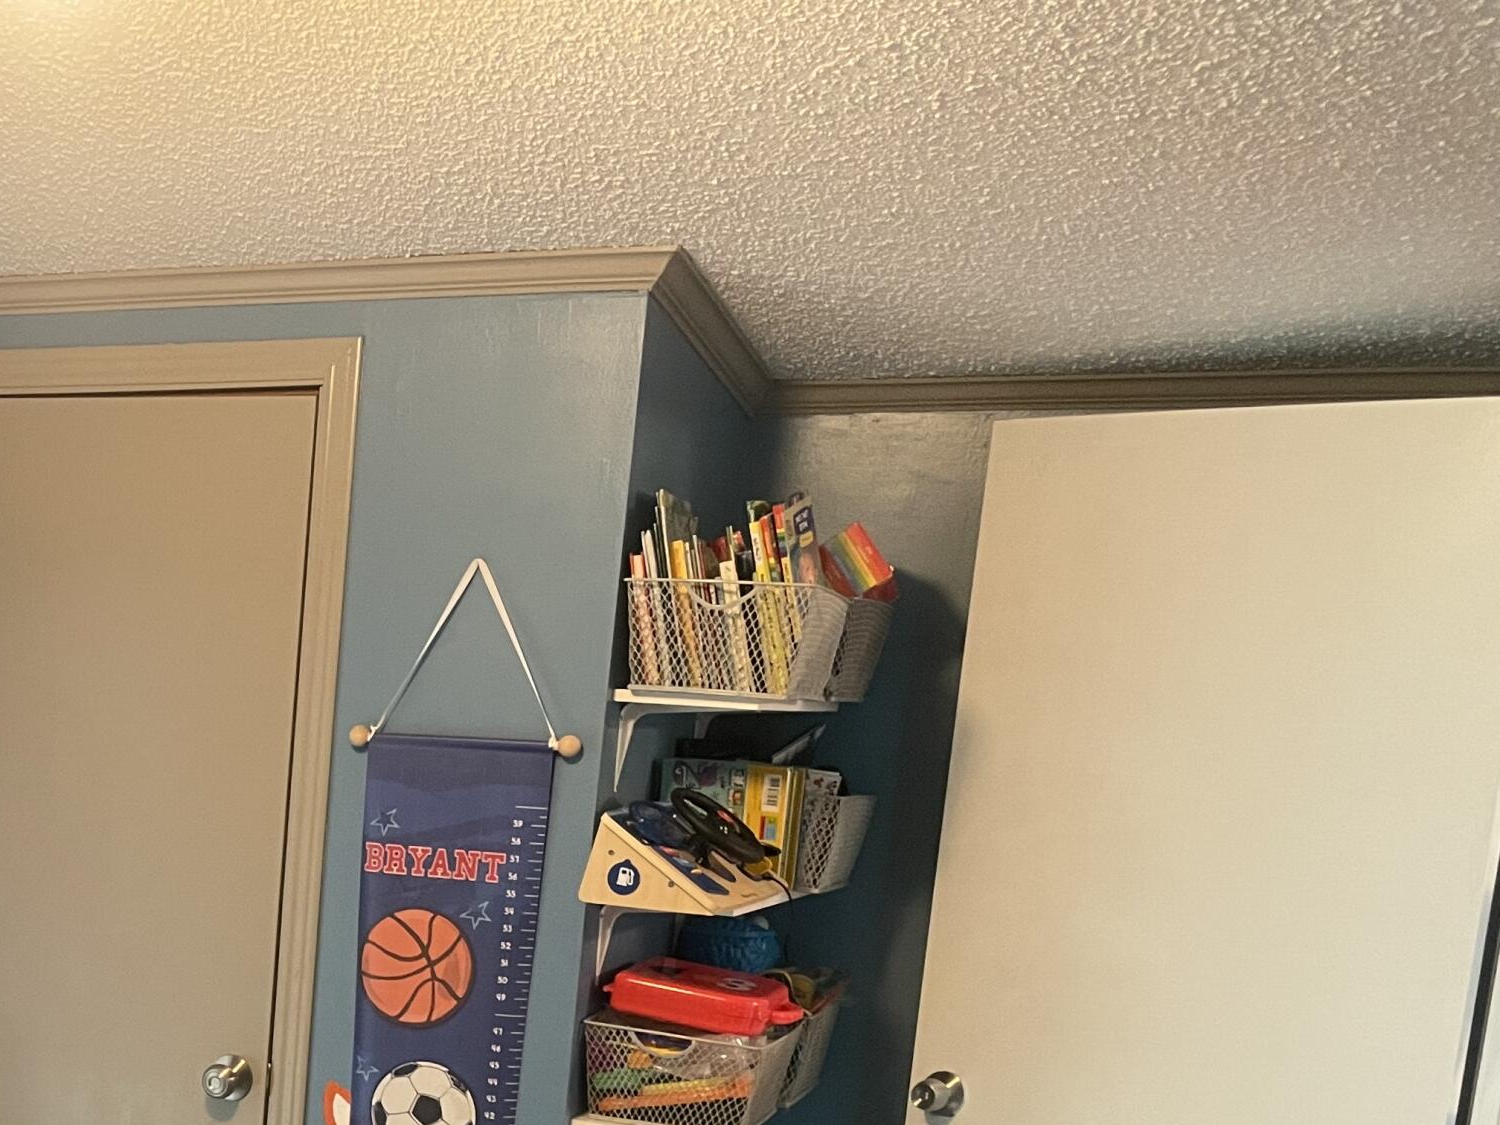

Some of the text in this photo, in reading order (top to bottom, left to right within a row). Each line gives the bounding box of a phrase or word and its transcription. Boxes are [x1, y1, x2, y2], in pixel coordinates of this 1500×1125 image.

[364, 841, 507, 884] BRYANT
[509, 854, 520, 863] 57
[508, 872, 518, 880] 56
[505, 889, 516, 898] 55
[503, 907, 515, 915] 54
[502, 924, 513, 933] 53
[500, 941, 512, 950] 52
[500, 958, 509, 967] 51
[497, 975, 509, 984] 50
[492, 1027, 503, 1036] 47
[491, 1044, 501, 1053] 46
[489, 1061, 500, 1069] 45
[485, 1094, 497, 1103] 43
[484, 1111, 496, 1120] 42
